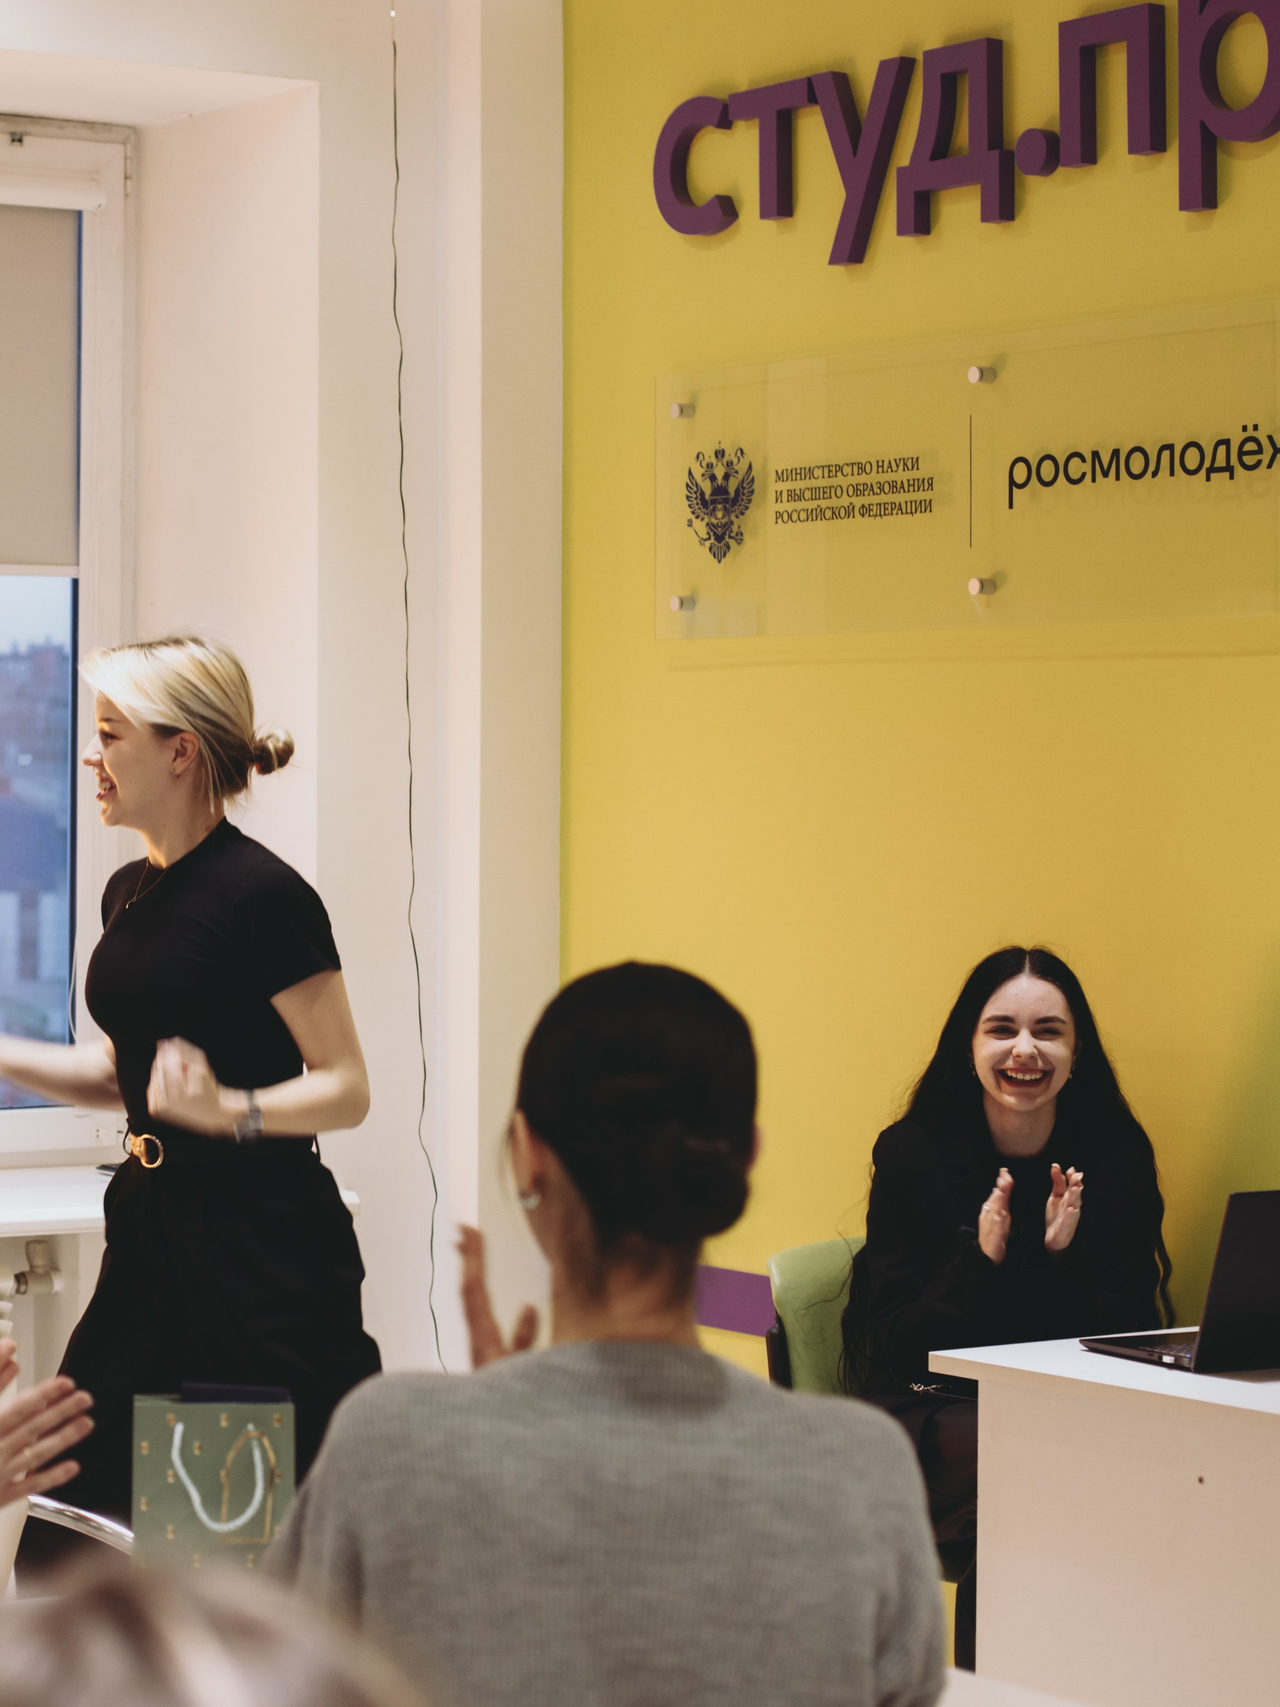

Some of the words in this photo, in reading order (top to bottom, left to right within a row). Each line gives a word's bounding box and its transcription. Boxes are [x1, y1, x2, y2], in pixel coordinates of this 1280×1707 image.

[652, 0, 1280, 267] студ.пр
[775, 461, 873, 483] МИНИСТЕРСТВО
[876, 456, 920, 474] НАУКИ
[775, 490, 783, 504] И
[786, 485, 843, 503] ВЫСШЕГО
[846, 477, 934, 498] ОБРАЗОВАНИЯ
[775, 502, 856, 525] РОССИЙСКОЙ
[858, 499, 933, 520] ФЕДЕРАЦИИ
